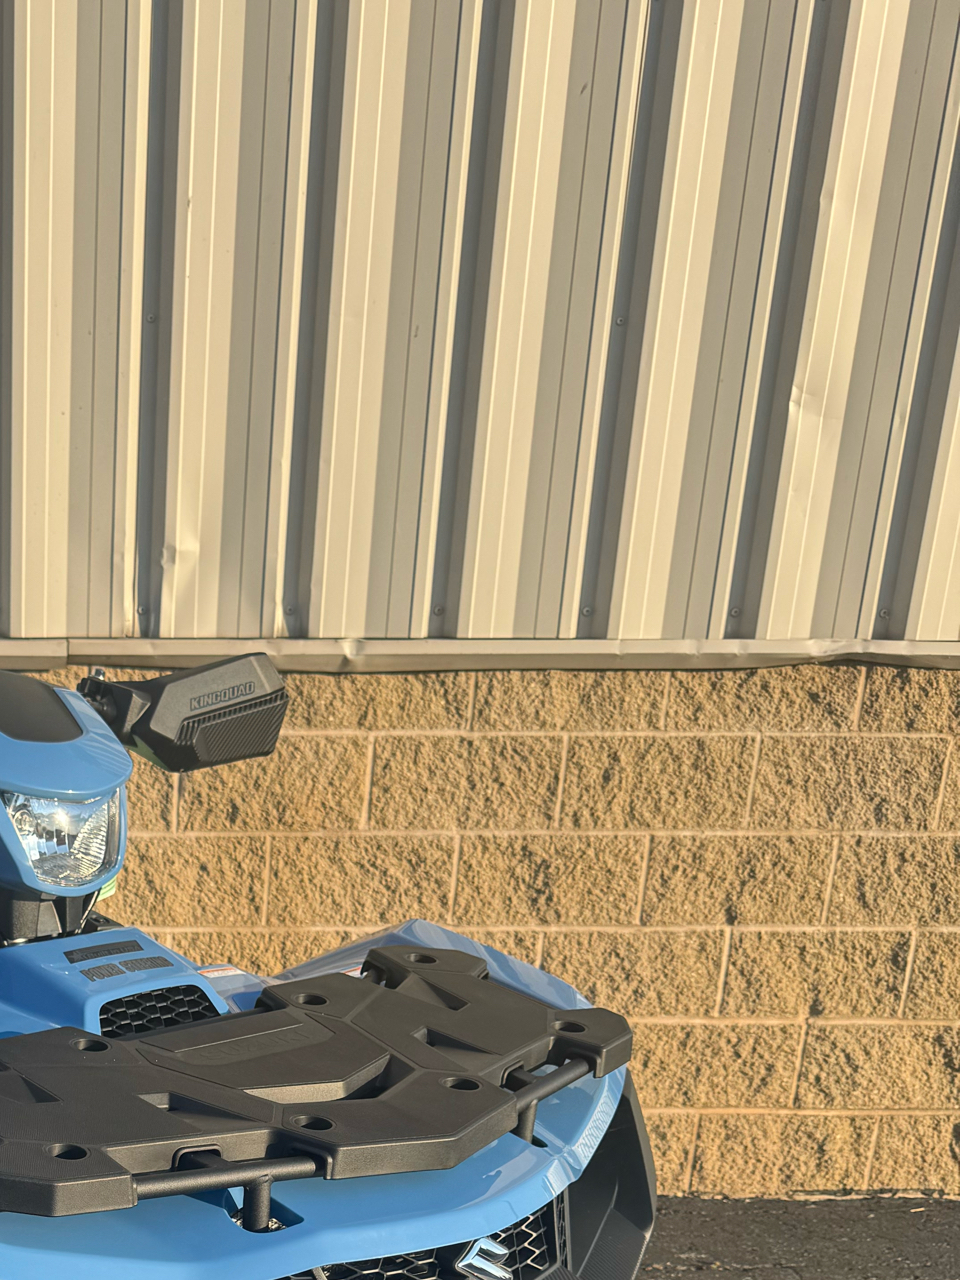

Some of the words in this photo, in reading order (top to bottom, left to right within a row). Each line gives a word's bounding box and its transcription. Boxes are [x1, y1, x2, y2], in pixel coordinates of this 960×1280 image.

[189, 681, 256, 712] KINGQUAD
[79, 963, 127, 983] POWER
[199, 1030, 311, 1061] SUZUKI
